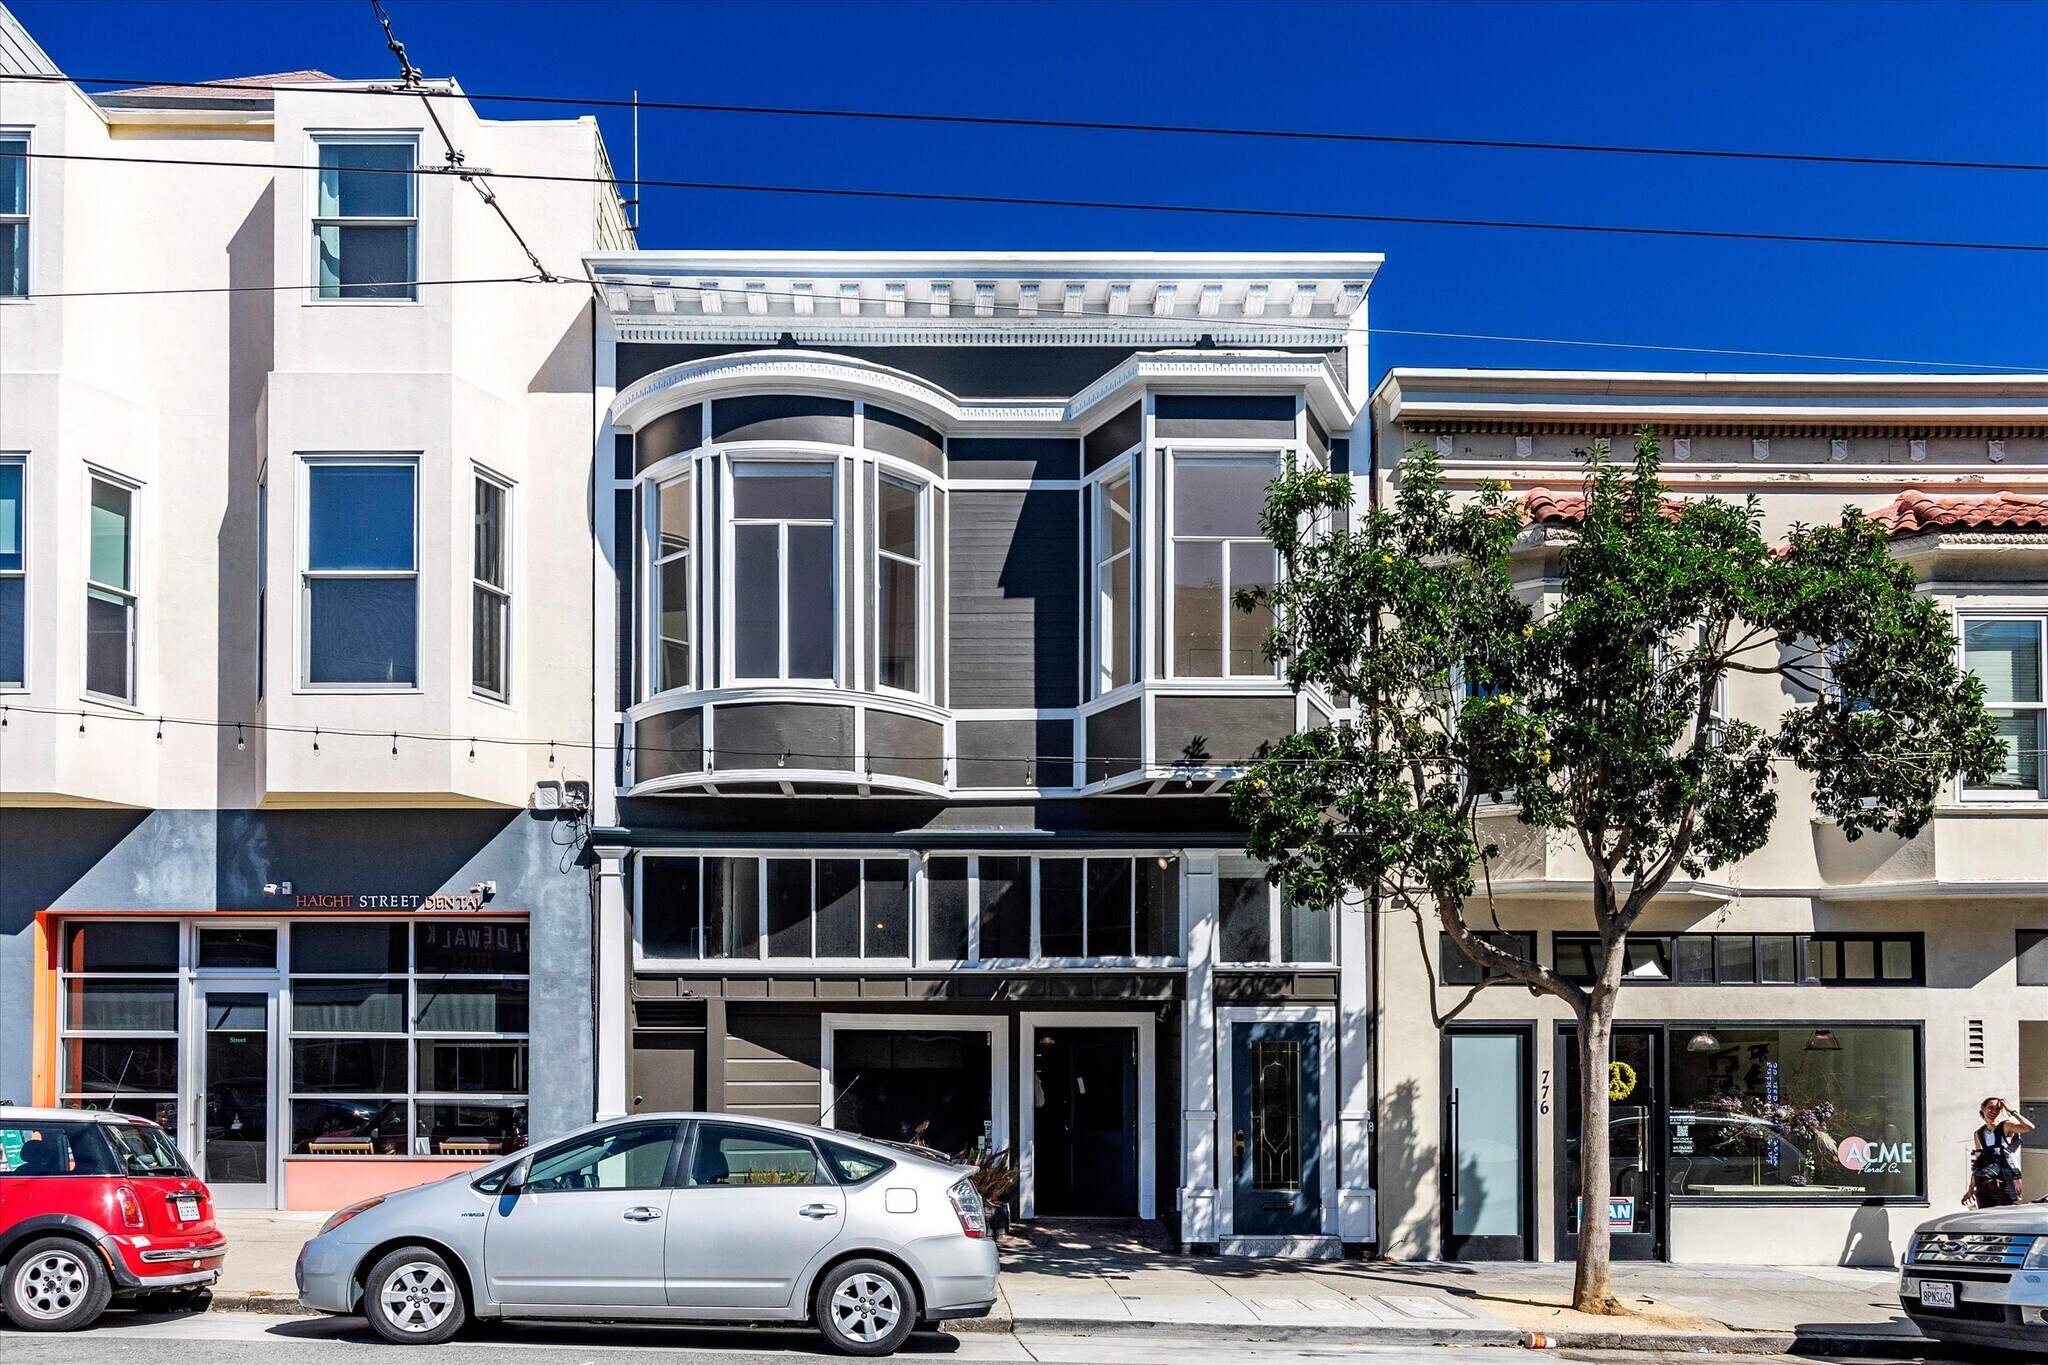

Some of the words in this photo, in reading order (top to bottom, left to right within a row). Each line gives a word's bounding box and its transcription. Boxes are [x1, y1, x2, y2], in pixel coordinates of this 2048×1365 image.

[295, 895, 353, 908] HAIGHT
[359, 895, 419, 908] STREET
[423, 895, 485, 911] DENTAL
[1540, 1070, 1550, 1115] 776
[1845, 1142, 1913, 1163] ACME
[1857, 1162, 1887, 1175] Floral
